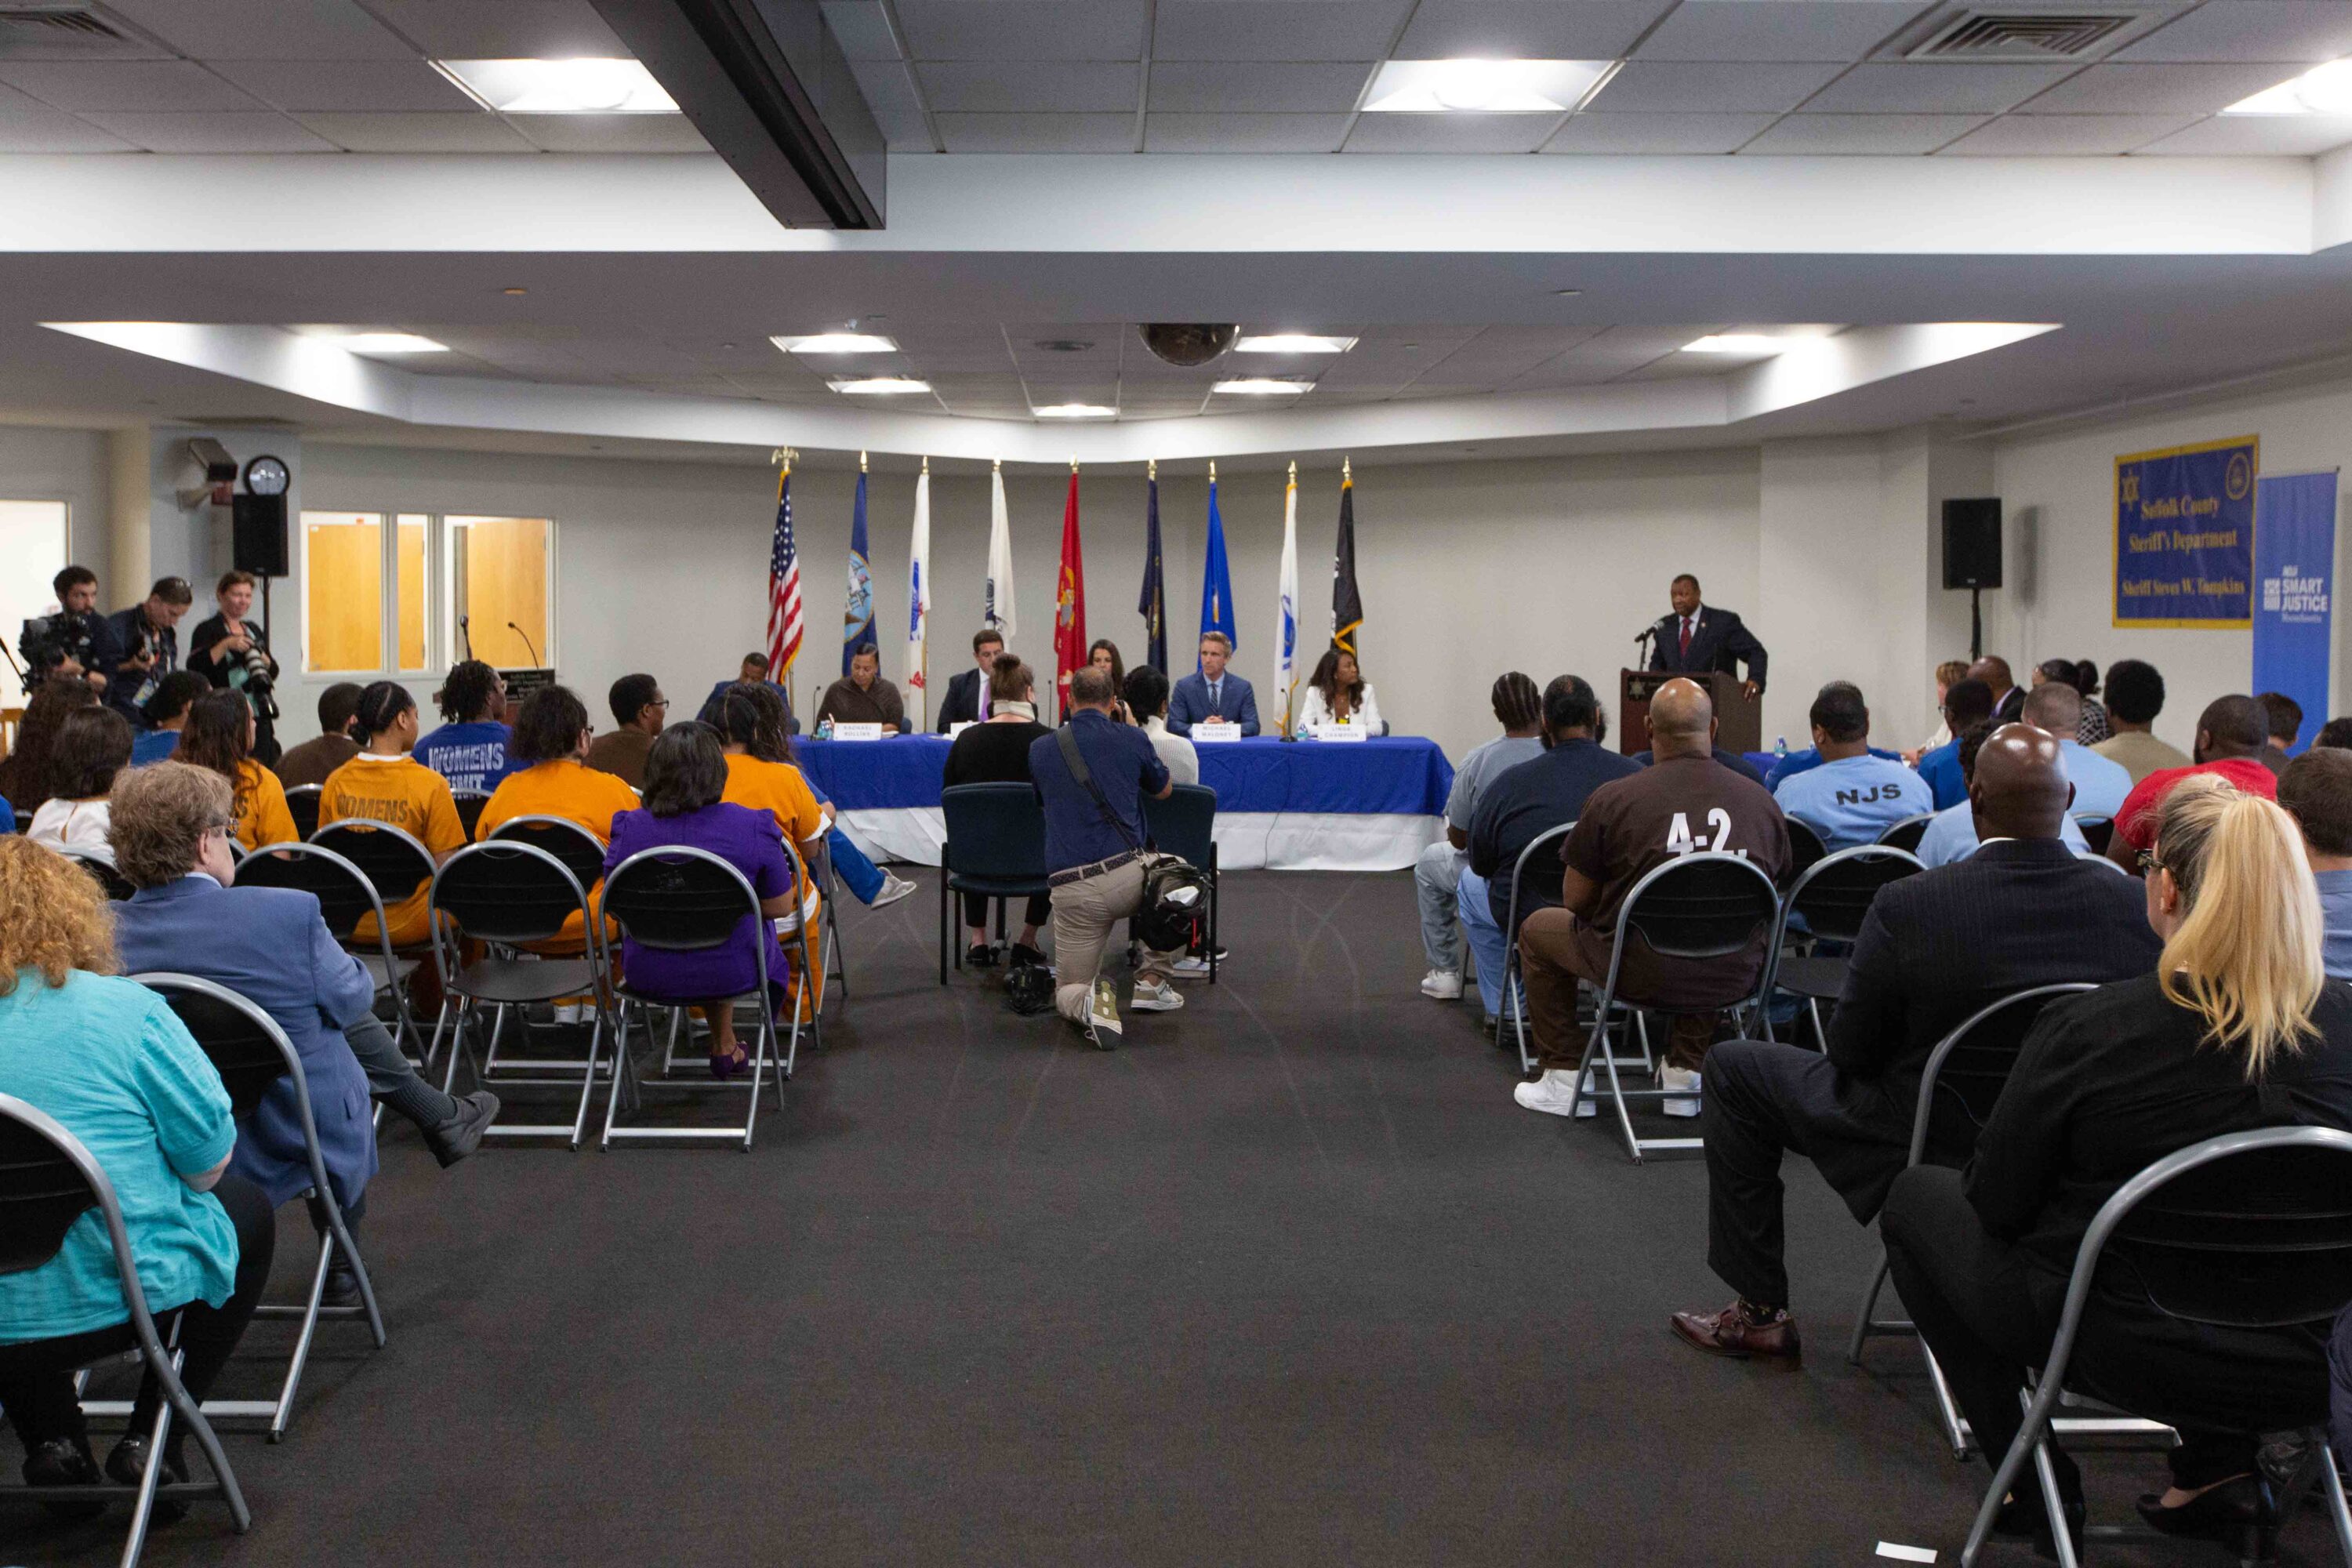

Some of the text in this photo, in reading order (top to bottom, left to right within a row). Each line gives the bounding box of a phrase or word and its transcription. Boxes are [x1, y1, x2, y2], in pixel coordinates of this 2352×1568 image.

[2181, 495, 2220, 518] County
[2173, 529, 2238, 556] Department
[2282, 577, 2324, 594] SMART
[2281, 594, 2328, 612] JUSTICE
[428, 742, 505, 773] WOMENS
[1835, 784, 1902, 806] NJS
[337, 793, 408, 822] WOMENS
